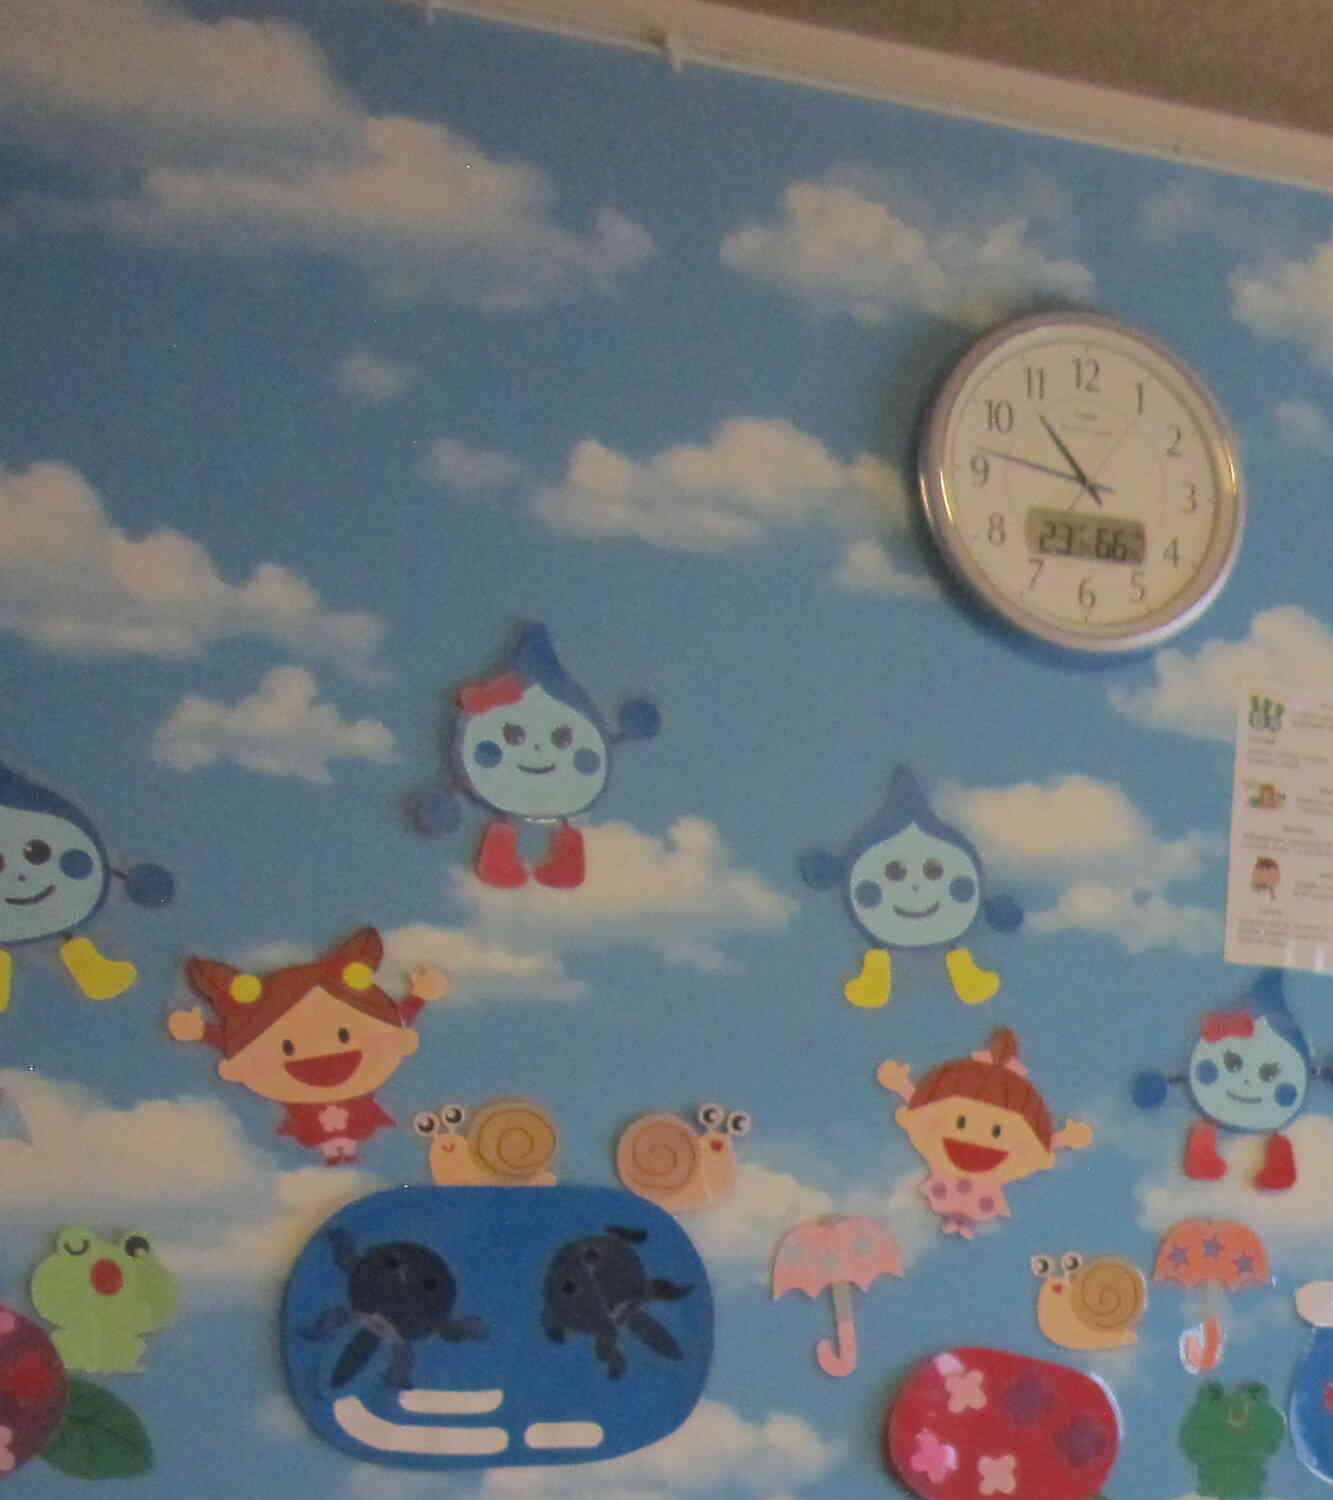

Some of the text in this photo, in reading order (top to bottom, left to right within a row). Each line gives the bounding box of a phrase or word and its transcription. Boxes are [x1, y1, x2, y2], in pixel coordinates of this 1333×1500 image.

[1026, 367, 1046, 399] 11
[1073, 359, 1100, 392] 12
[1135, 382, 1145, 415] 1
[985, 399, 1014, 433] 10
[1166, 424, 1183, 457] 2
[971, 455, 990, 487] 9
[1185, 483, 1198, 514] 3
[987, 512, 1006, 546] 8
[1164, 538, 1180, 567] 4
[1028, 557, 1045, 589] 7
[1131, 572, 1145, 602] 5
[1078, 577, 1096, 609] 6
